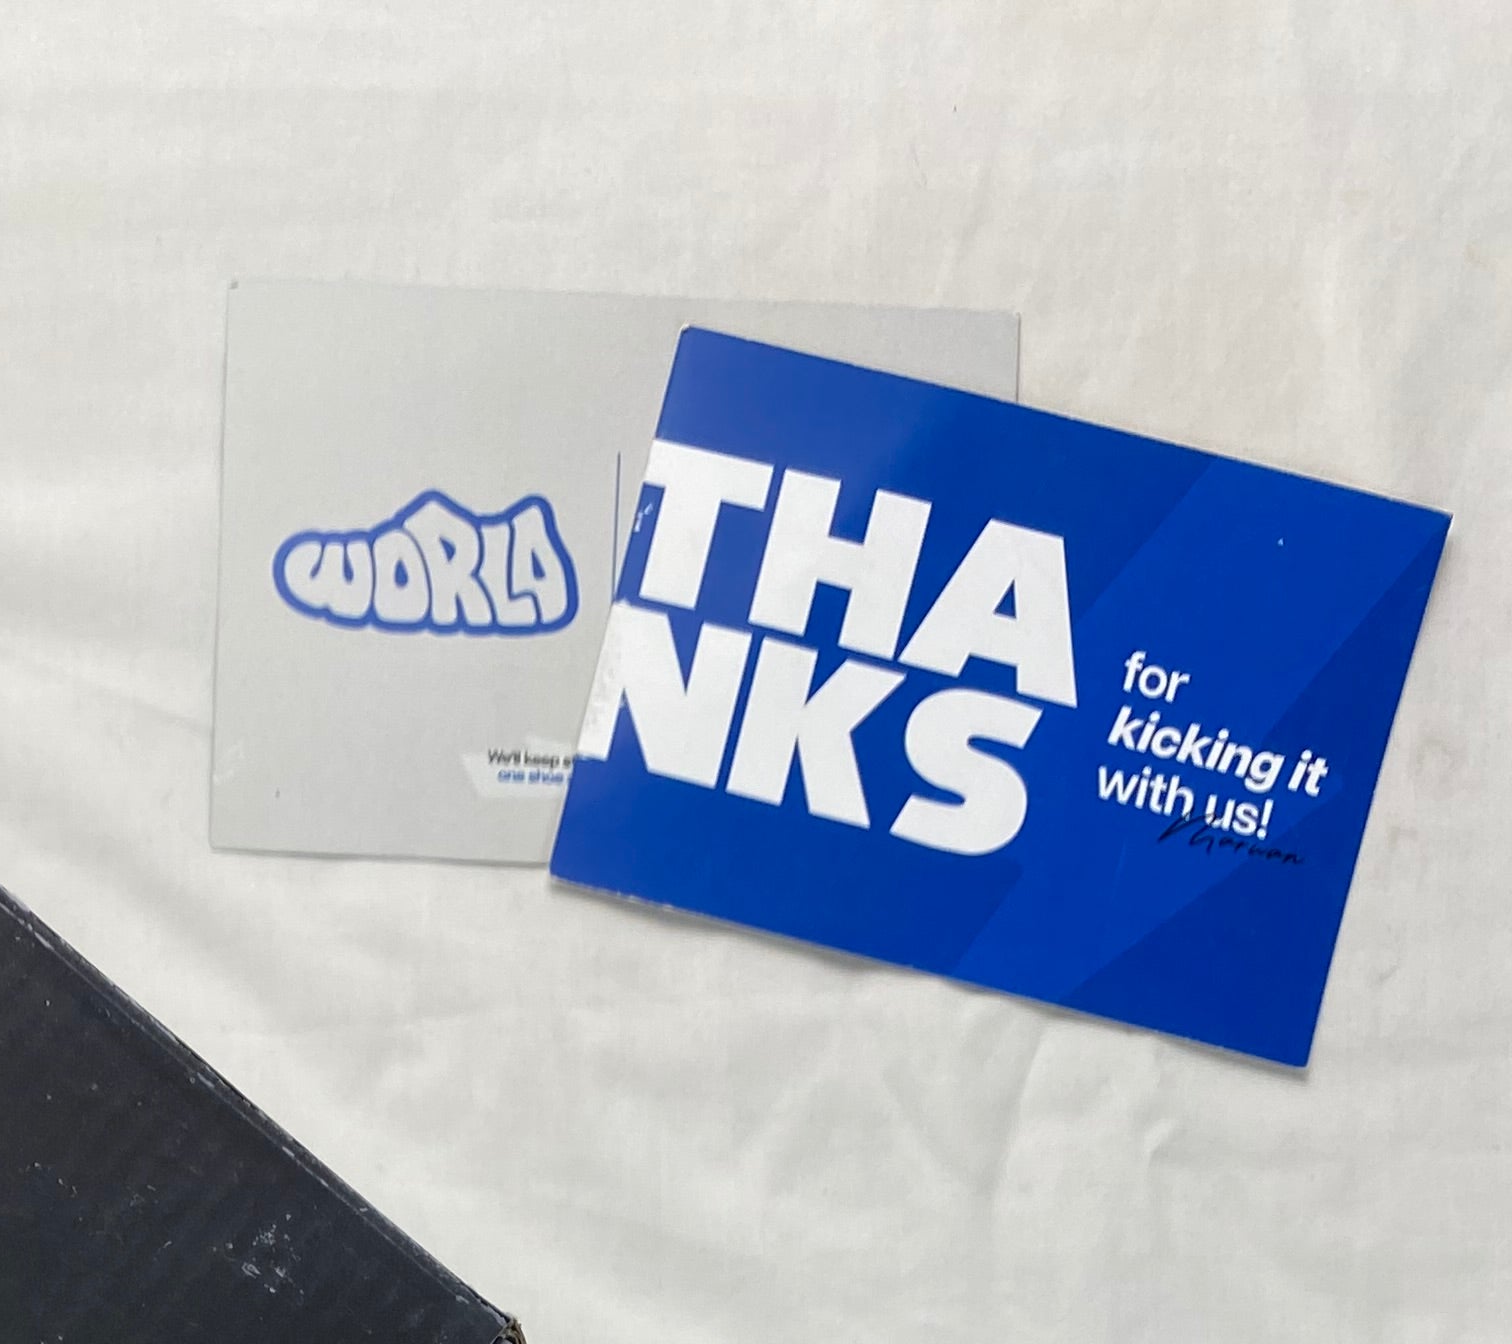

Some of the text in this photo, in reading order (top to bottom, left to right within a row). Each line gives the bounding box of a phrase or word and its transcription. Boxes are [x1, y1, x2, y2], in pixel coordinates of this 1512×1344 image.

[640, 439, 1077, 708] THA
[1123, 651, 1190, 703] for
[577, 601, 1044, 856] NKS
[1107, 705, 1329, 797] kicking it
[1098, 765, 1274, 840] with us!
